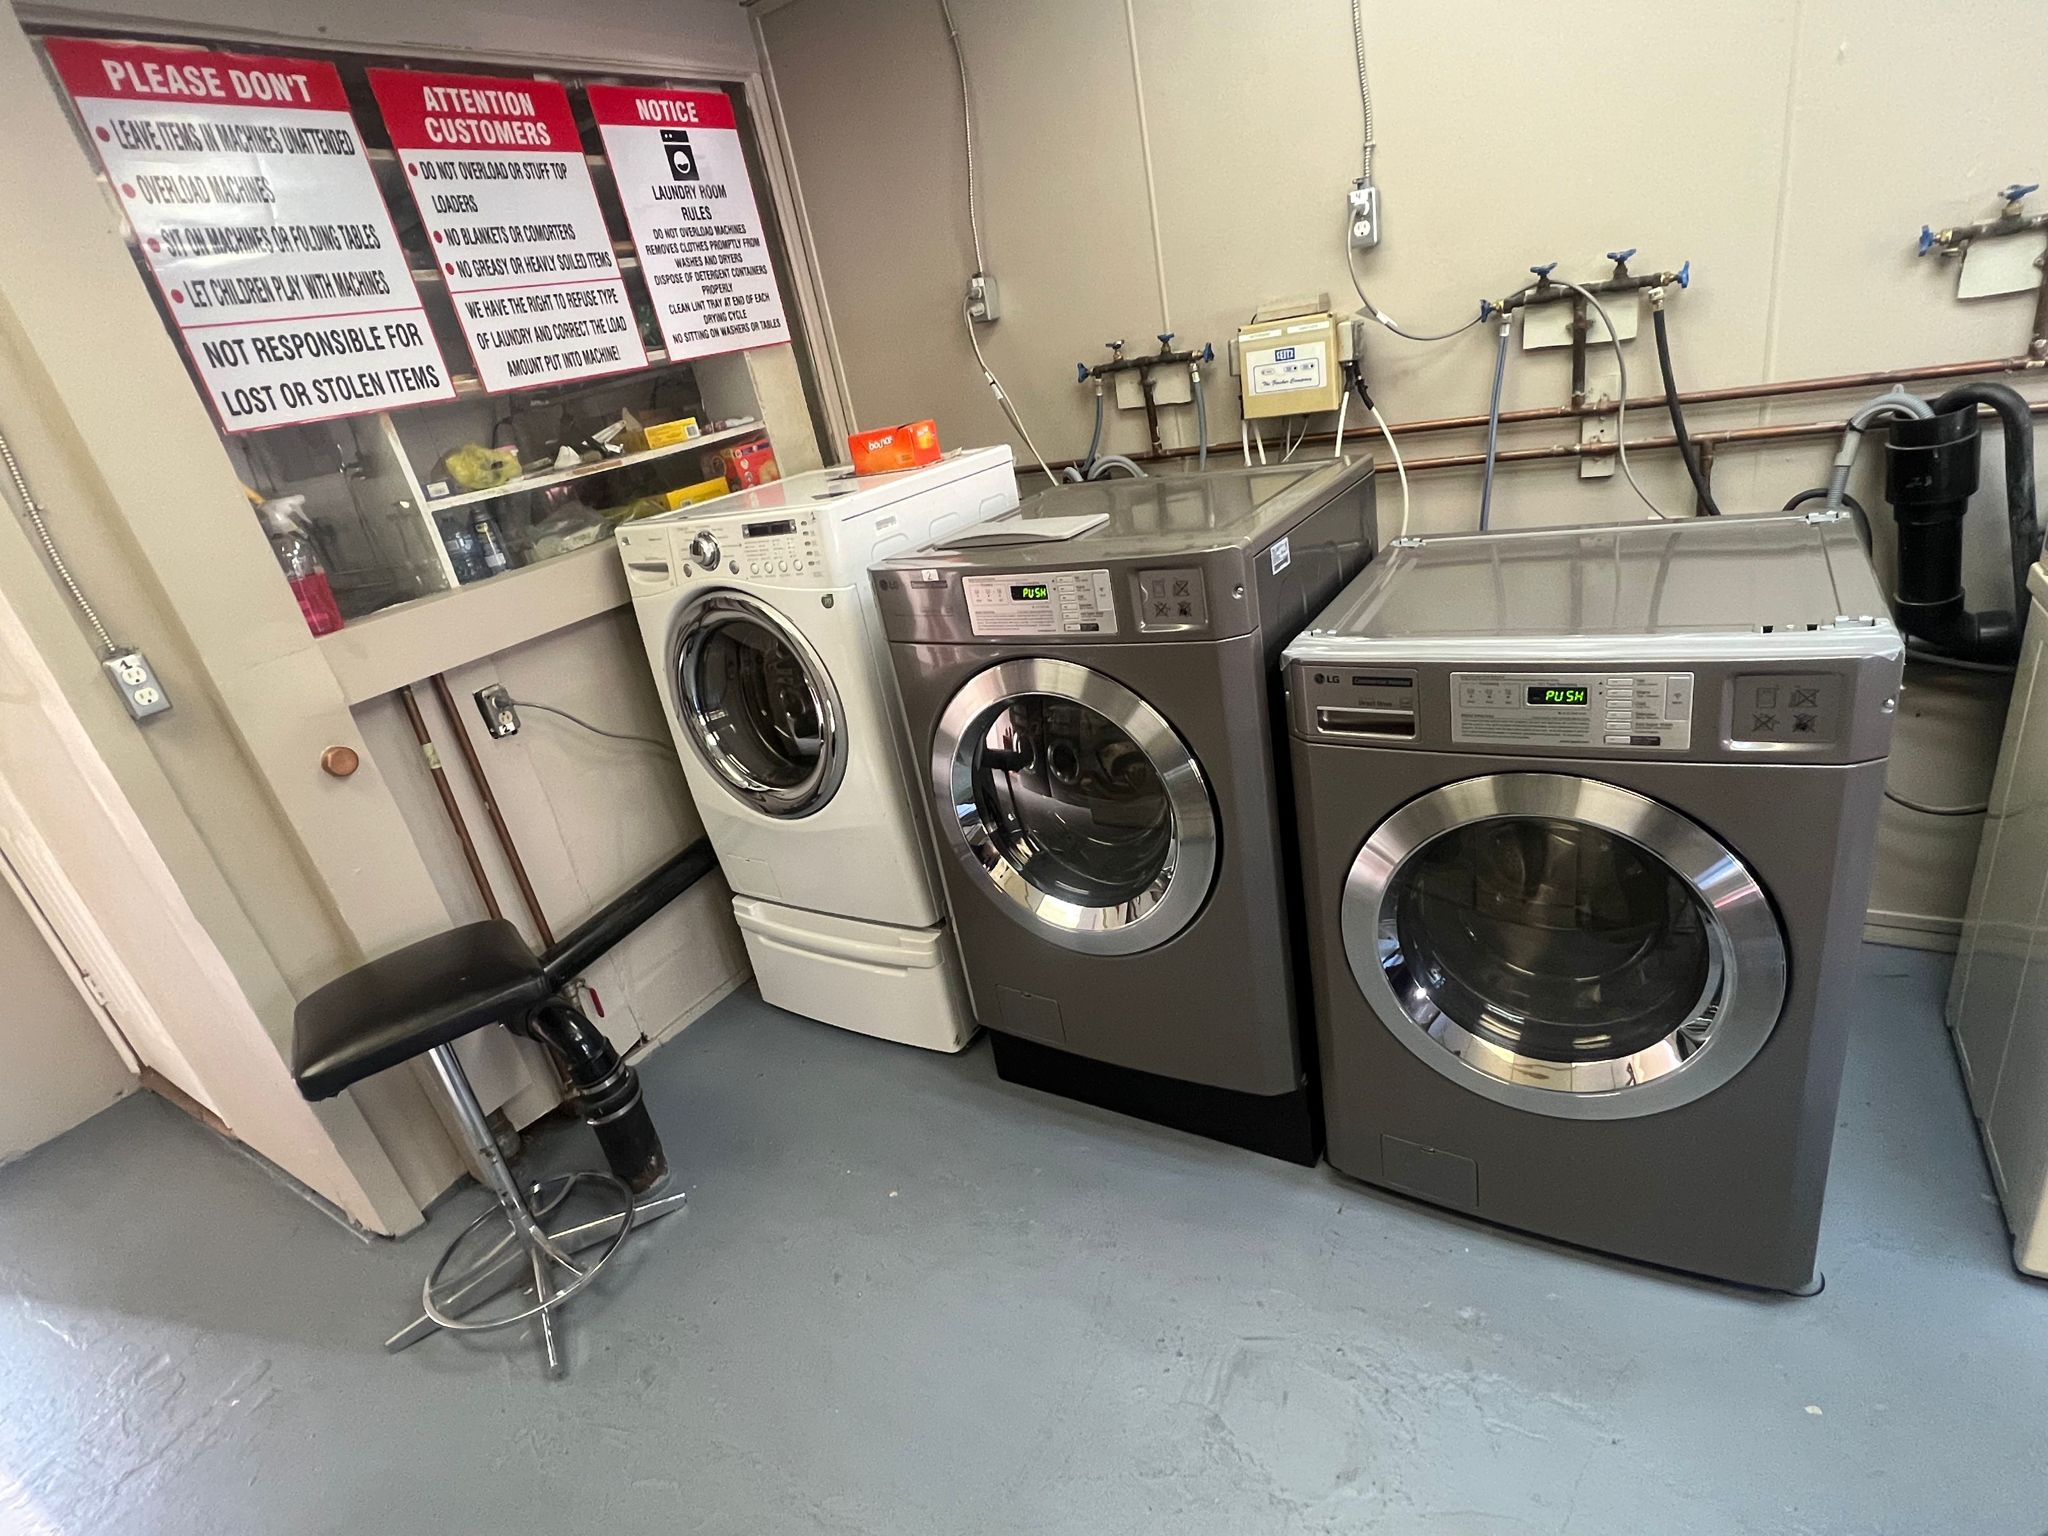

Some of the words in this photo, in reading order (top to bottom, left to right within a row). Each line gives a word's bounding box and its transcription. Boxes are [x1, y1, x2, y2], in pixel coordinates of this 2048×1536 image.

[101, 59, 225, 98] PLEASE
[231, 69, 313, 103] DON'T
[422, 86, 535, 117] ATTENTION
[635, 98, 700, 124] NOTICE
[110, 119, 161, 150] LEAVE
[157, 120, 199, 151] ITEMS
[199, 123, 221, 152] IN
[215, 124, 284, 154] MACHINES
[279, 127, 356, 156] UNATTENDED
[424, 118, 551, 146] CUSTOMERS
[419, 161, 436, 180] DO
[436, 162, 458, 180] NOT
[458, 162, 509, 180] OVERLOAD
[508, 162, 524, 180] OR
[523, 162, 551, 180] STUFF
[550, 162, 567, 179] TOP
[136, 174, 210, 204] OVERLOAD
[207, 176, 276, 203] MACHINES
[652, 184, 700, 200] LAUNDRY
[700, 184, 728, 199] ROOM
[431, 195, 478, 213] LOADERS
[681, 205, 712, 221] RULES
[160, 228, 187, 257] SIT
[185, 227, 208, 256] ON
[205, 226, 271, 255] MACHINES
[271, 226, 292, 252] OR
[290, 226, 340, 252] FOLDING
[337, 224, 381, 250] TABLES
[444, 228, 461, 246] NO
[460, 226, 509, 245] BLANKETS
[508, 225, 524, 243] OR
[523, 223, 576, 242] COMORTERS
[653, 228, 664, 239] DO
[665, 227, 680, 239] NOT
[680, 225, 715, 238] OVERLOAD
[714, 224, 747, 236] MACHINES
[645, 243, 679, 255] REMOVES
[680, 241, 710, 254] CLOTHES
[709, 239, 743, 252] PROMPTLY
[743, 237, 760, 249] FROM
[456, 260, 472, 278] NO
[474, 257, 510, 277] GREASY
[510, 257, 525, 274] OR
[556, 253, 587, 270] SOILED
[586, 251, 612, 268] ITEMS
[674, 256, 703, 269] WASHES
[704, 255, 718, 266] AND
[718, 253, 743, 265] DRYERS
[654, 273, 684, 286] DISPOSE
[685, 272, 694, 283] OF
[694, 269, 732, 282] DETERGENT
[731, 265, 768, 279] CONTAINERS
[184, 280, 213, 308] LET
[211, 276, 276, 306] CHILDREN
[271, 275, 303, 302] PLAY
[300, 273, 333, 299] WITH
[329, 270, 391, 298] MACHINES
[702, 283, 734, 295] PROPERLY
[465, 301, 484, 319] WE
[483, 298, 511, 317] HAVE
[509, 297, 528, 315] THE
[528, 294, 554, 313] RIGHT
[552, 293, 567, 310] TO
[566, 290, 598, 308] REFUSE
[597, 288, 619, 306] TYPE
[668, 302, 692, 315] CLEAN
[692, 300, 707, 312] LINT
[706, 298, 723, 310] TRAY
[724, 297, 733, 307] AT
[732, 295, 745, 307] END
[745, 294, 756, 305] OF
[754, 292, 771, 303] EACH
[703, 312, 728, 325] DRYING
[728, 309, 748, 321] CYCLE
[476, 332, 490, 350] OF
[490, 327, 533, 348] LAUNDRY
[533, 325, 553, 343] AND
[552, 319, 592, 341] CORRECT
[588, 318, 607, 335] THE
[605, 315, 627, 333] LOAD
[673, 333, 684, 344] NO
[684, 329, 710, 342] SITTING
[710, 327, 720, 338] ON
[719, 322, 751, 337] WASHERS
[751, 321, 761, 332] OR
[759, 318, 782, 330] TABLES
[202, 339, 250, 369] NOT
[255, 327, 385, 362] RESPONSIBLE
[384, 323, 423, 348] FOR
[506, 355, 545, 377] AMOUNT
[544, 353, 563, 372] PUT
[561, 350, 582, 369] INTO
[580, 345, 621, 366] MACHINE!
[221, 386, 276, 417] LOST
[280, 381, 313, 410] OR
[312, 372, 386, 403] STOLEN
[386, 364, 441, 393] ITEMS
[1022, 588, 1047, 598] PUSH
[1326, 675, 1340, 684] LG
[1545, 690, 1584, 702] PUSH
